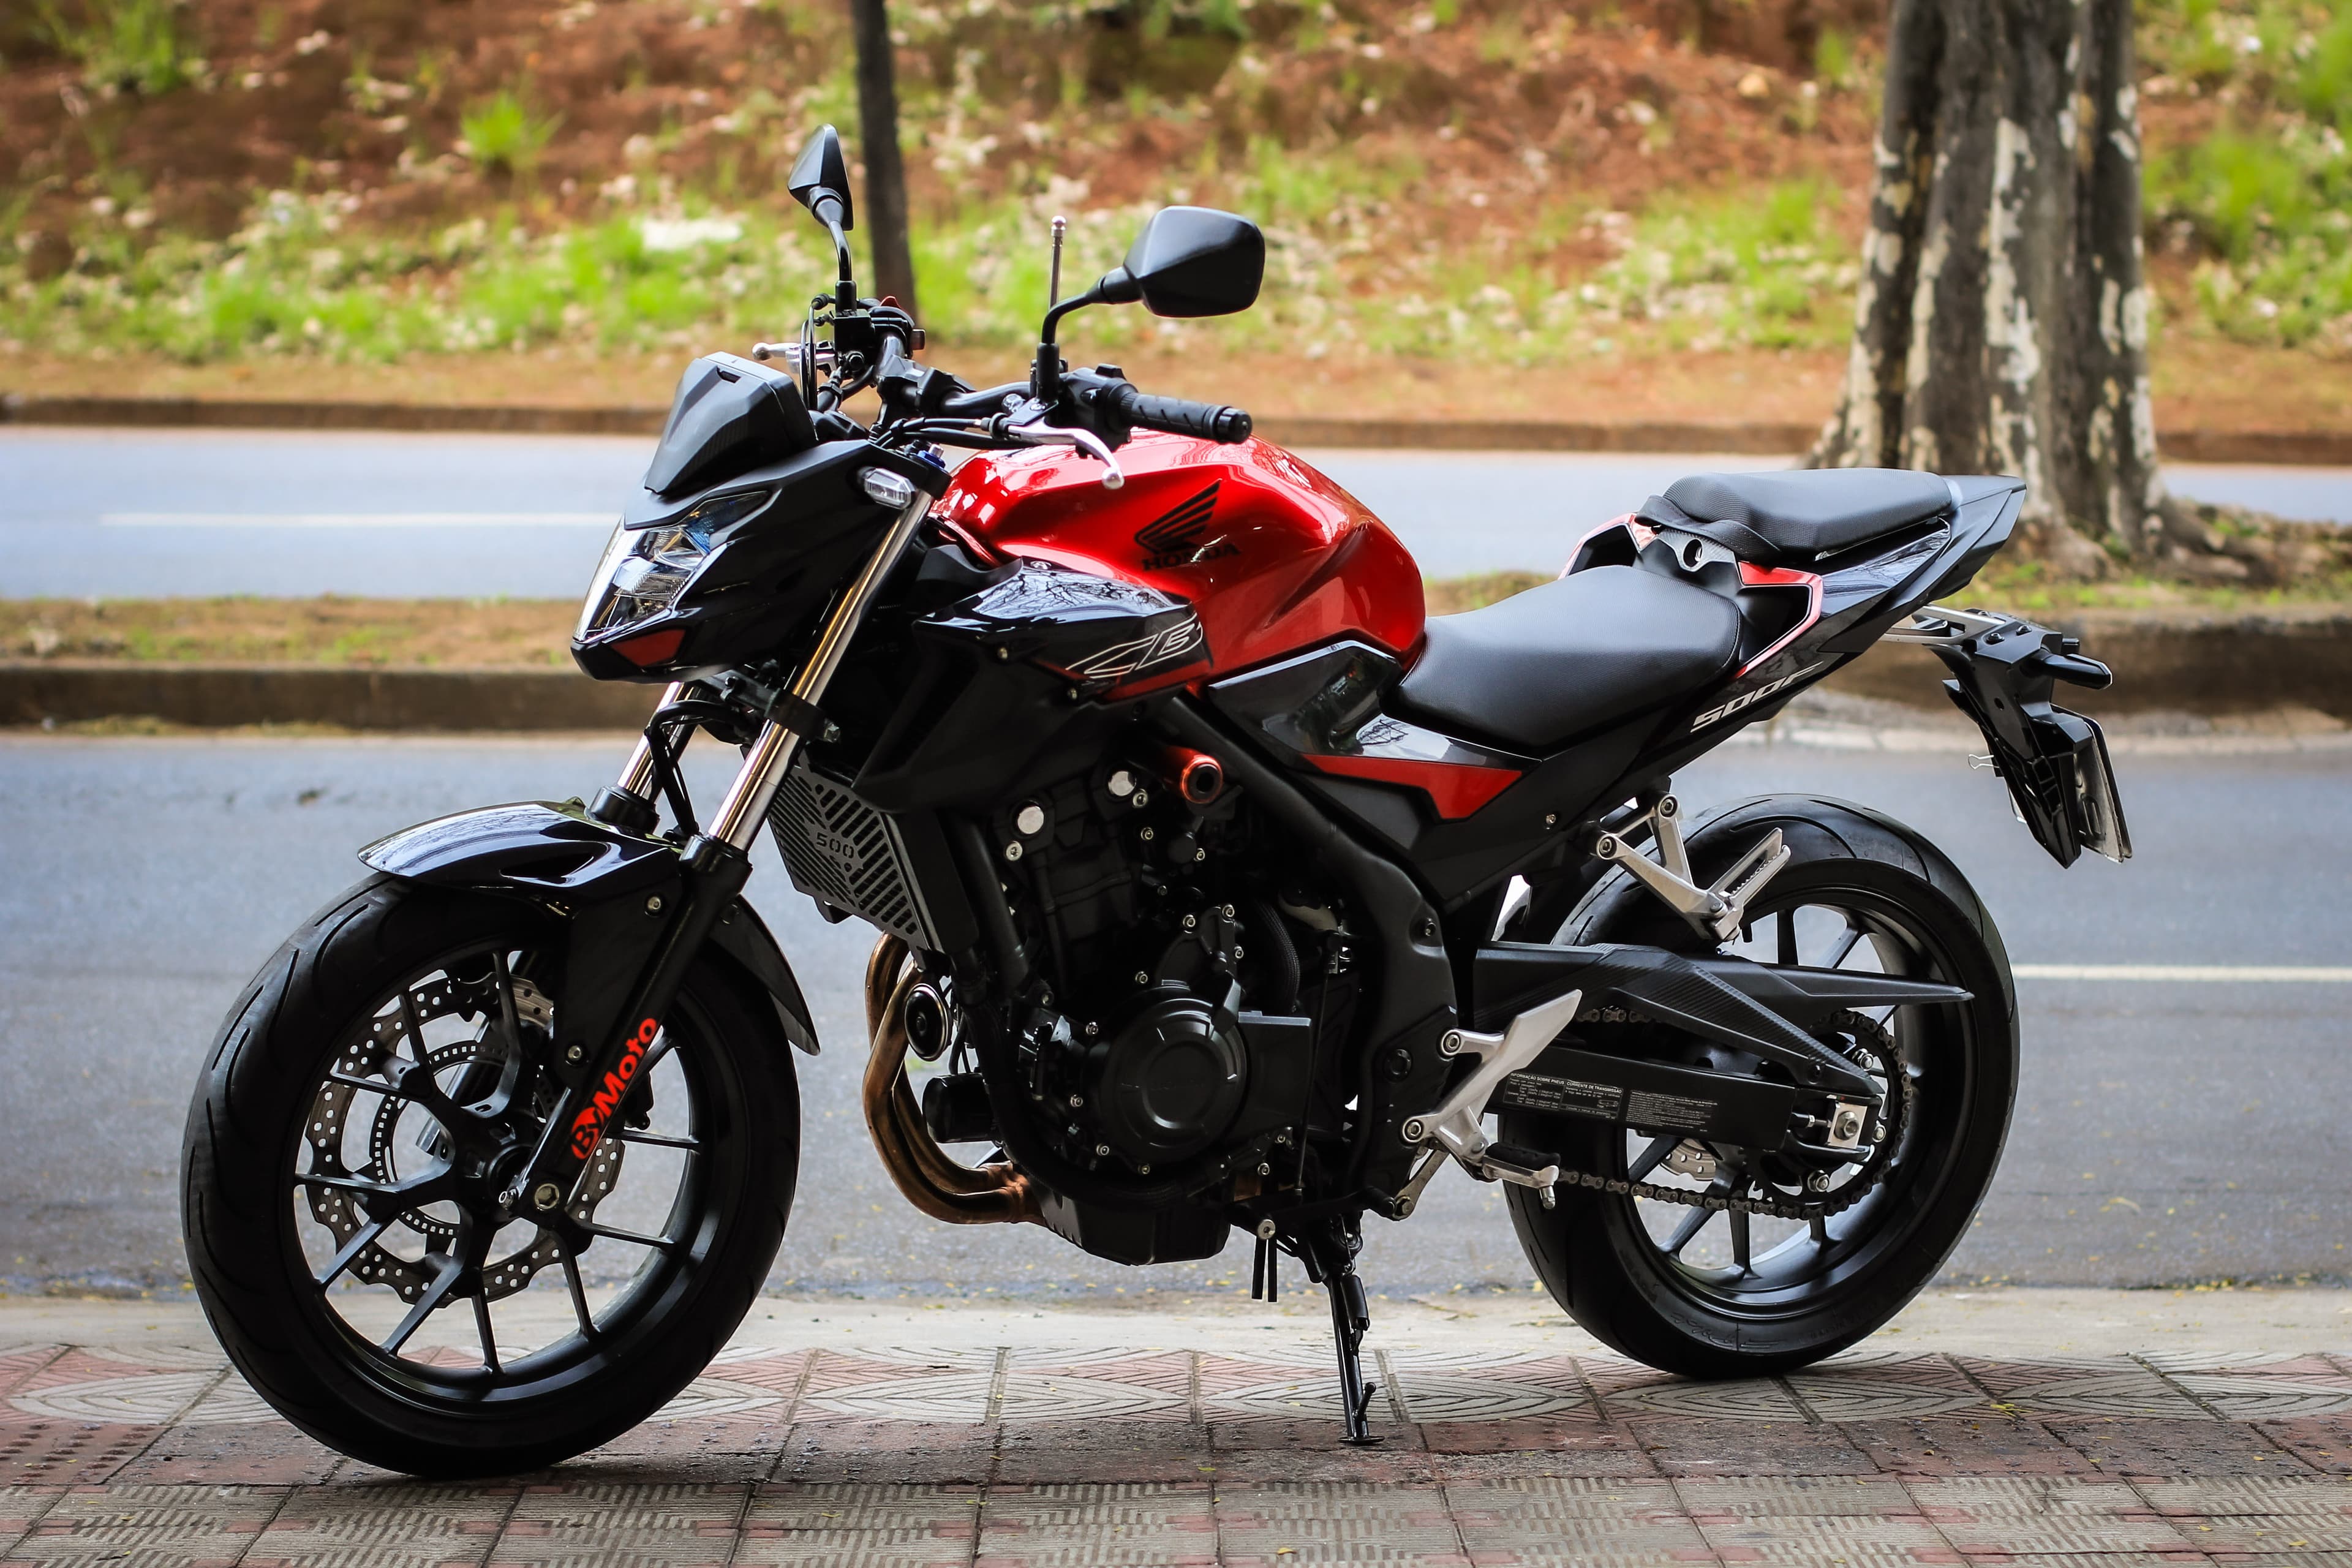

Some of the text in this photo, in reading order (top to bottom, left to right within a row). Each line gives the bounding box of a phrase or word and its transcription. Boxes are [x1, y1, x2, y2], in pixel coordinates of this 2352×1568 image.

[1141, 543, 1242, 570] HONDA
[1065, 612, 1204, 679] CB
[1690, 660, 1825, 733] 500F
[816, 832, 854, 859] 500
